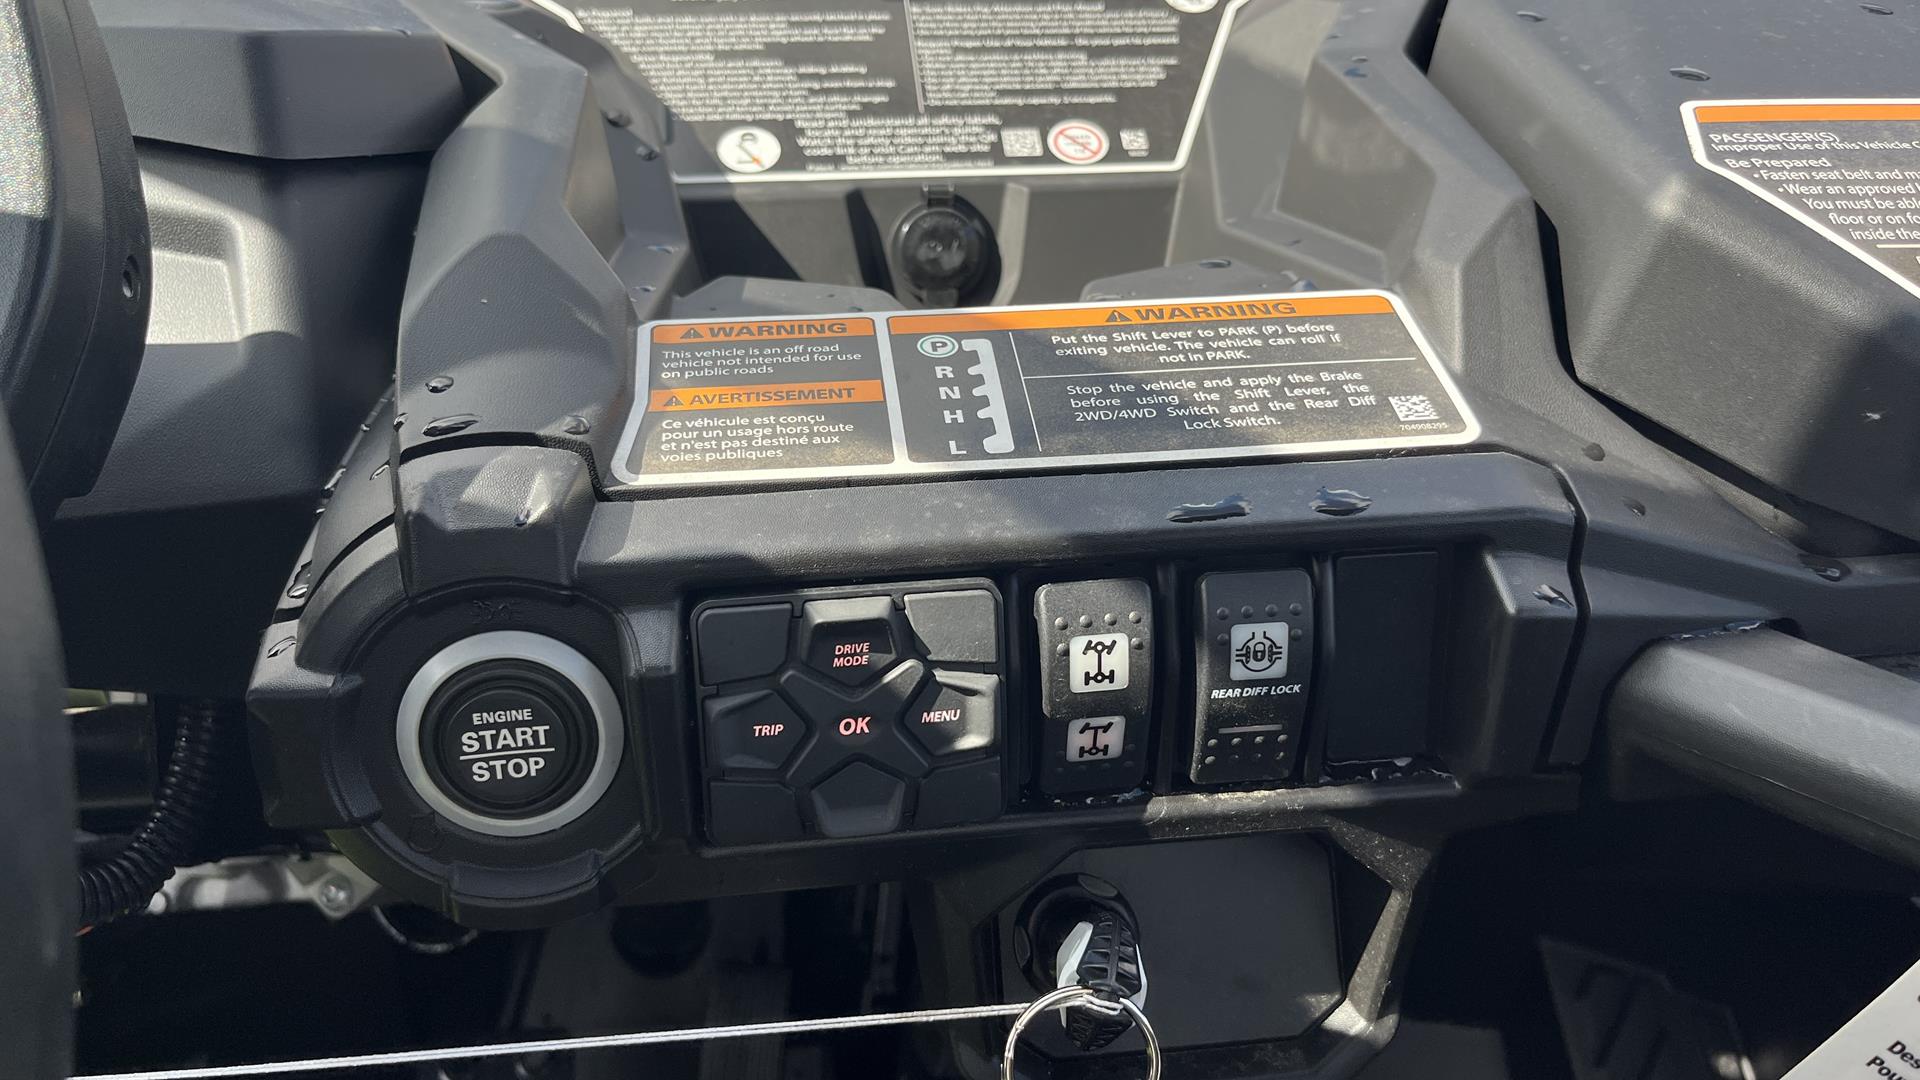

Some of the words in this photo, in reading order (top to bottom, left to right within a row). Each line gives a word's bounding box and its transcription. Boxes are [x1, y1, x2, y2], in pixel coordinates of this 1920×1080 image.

[1709, 132, 1840, 144] PASSENGER(S)
[1711, 143, 1787, 152] Improper
[1788, 142, 1815, 151] Use
[1816, 141, 1830, 150] of
[1831, 141, 1859, 150] this
[1858, 141, 1912, 149] Vehicle
[1724, 159, 1748, 169] Be
[1755, 158, 1832, 170] Prepared
[1813, 170, 1843, 180] seat
[1842, 169, 1874, 180] belt
[1874, 169, 1903, 180] and
[1825, 186, 1846, 195] an
[1846, 183, 1916, 197] approved
[1802, 198, 1835, 210] You
[1837, 199, 1874, 209] must
[1873, 197, 1895, 209] be
[1828, 213, 1864, 225] floor
[1867, 215, 1883, 225] or
[1885, 215, 1906, 225] on
[1849, 228, 1896, 240] inside
[1134, 302, 1297, 321] WARNING
[709, 323, 847, 338] WARNING
[1051, 335, 1077, 345] Put
[1081, 333, 1108, 343] the
[1112, 331, 1148, 342] Shift
[1152, 330, 1192, 340] Lever
[1197, 329, 1214, 337] to
[1218, 327, 1257, 336] PARK
[1262, 325, 1282, 335] (P)
[1286, 323, 1335, 334] before
[662, 350, 691, 359] This
[695, 347, 746, 358] vehicle
[749, 346, 760, 355] is
[764, 347, 781, 355] an
[784, 344, 804, 354] off
[807, 343, 839, 353] road
[930, 341, 948, 352] P
[1055, 346, 1108, 356] exiting
[1113, 342, 1171, 354] vehicle.
[1173, 341, 1204, 350] The
[1209, 338, 1262, 349] vehicle
[1268, 337, 1295, 346] can
[1300, 334, 1326, 345] roll
[1329, 333, 1342, 343] if
[662, 358, 713, 369] vehicle
[717, 357, 742, 366] not
[745, 354, 810, 365] intended
[813, 353, 833, 362] for
[837, 352, 862, 361] use
[1159, 354, 1186, 363] not
[1189, 352, 1203, 361] in
[1207, 350, 1250, 361] PARK.
[661, 370, 681, 379] on
[685, 367, 730, 380] public
[734, 365, 774, 375] roads
[934, 366, 955, 379] R
[1066, 385, 1102, 396] Stop
[1109, 382, 1135, 392] the
[1142, 379, 1196, 391] vehicle
[1203, 377, 1232, 388] and
[1239, 374, 1282, 386] apply
[1288, 372, 1315, 382] the
[1320, 370, 1363, 381] Brake
[690, 388, 855, 405] AVERTISSEMENT
[938, 386, 961, 400] N
[1070, 397, 1121, 408] before
[1136, 394, 1179, 406] using
[1193, 391, 1220, 402] the
[1234, 388, 1271, 399] Shift
[1285, 386, 1330, 397] Lever,
[1342, 383, 1369, 393] the
[1075, 408, 1157, 422] 2WD/4WD
[1167, 404, 1219, 417] Switch
[1229, 401, 1259, 413] and
[1268, 400, 1295, 411] the
[1304, 398, 1339, 409] Rear
[1348, 395, 1377, 407] Diff
[662, 419, 681, 429] Ce
[685, 416, 749, 428] véhicule
[753, 415, 776, 425] est
[779, 414, 825, 425] conçu
[943, 410, 964, 424] H
[1183, 418, 1221, 430] Lock
[1223, 414, 1281, 428] Switch.
[662, 431, 699, 442] pour
[703, 429, 722, 438] un
[727, 427, 772, 438] usage
[776, 424, 809, 435] hors
[813, 423, 854, 433] route
[661, 442, 677, 451] et
[681, 440, 717, 450] n'est
[721, 439, 748, 450] pas
[751, 435, 808, 447] destiné
[812, 435, 840, 444] aux
[949, 440, 967, 455] L
[660, 452, 701, 463] voies
[705, 449, 783, 463] publiques
[834, 642, 870, 655] DRIVE
[833, 655, 869, 668] MODE
[1210, 688, 1241, 699] REAR
[1243, 686, 1269, 697] DIFF
[1270, 684, 1302, 696] LOCK
[472, 709, 533, 725] ENGINE
[921, 709, 960, 723] MENU
[753, 724, 784, 737] TRIP
[838, 716, 871, 735] OK
[461, 725, 550, 753] START
[472, 757, 545, 782] STOP
